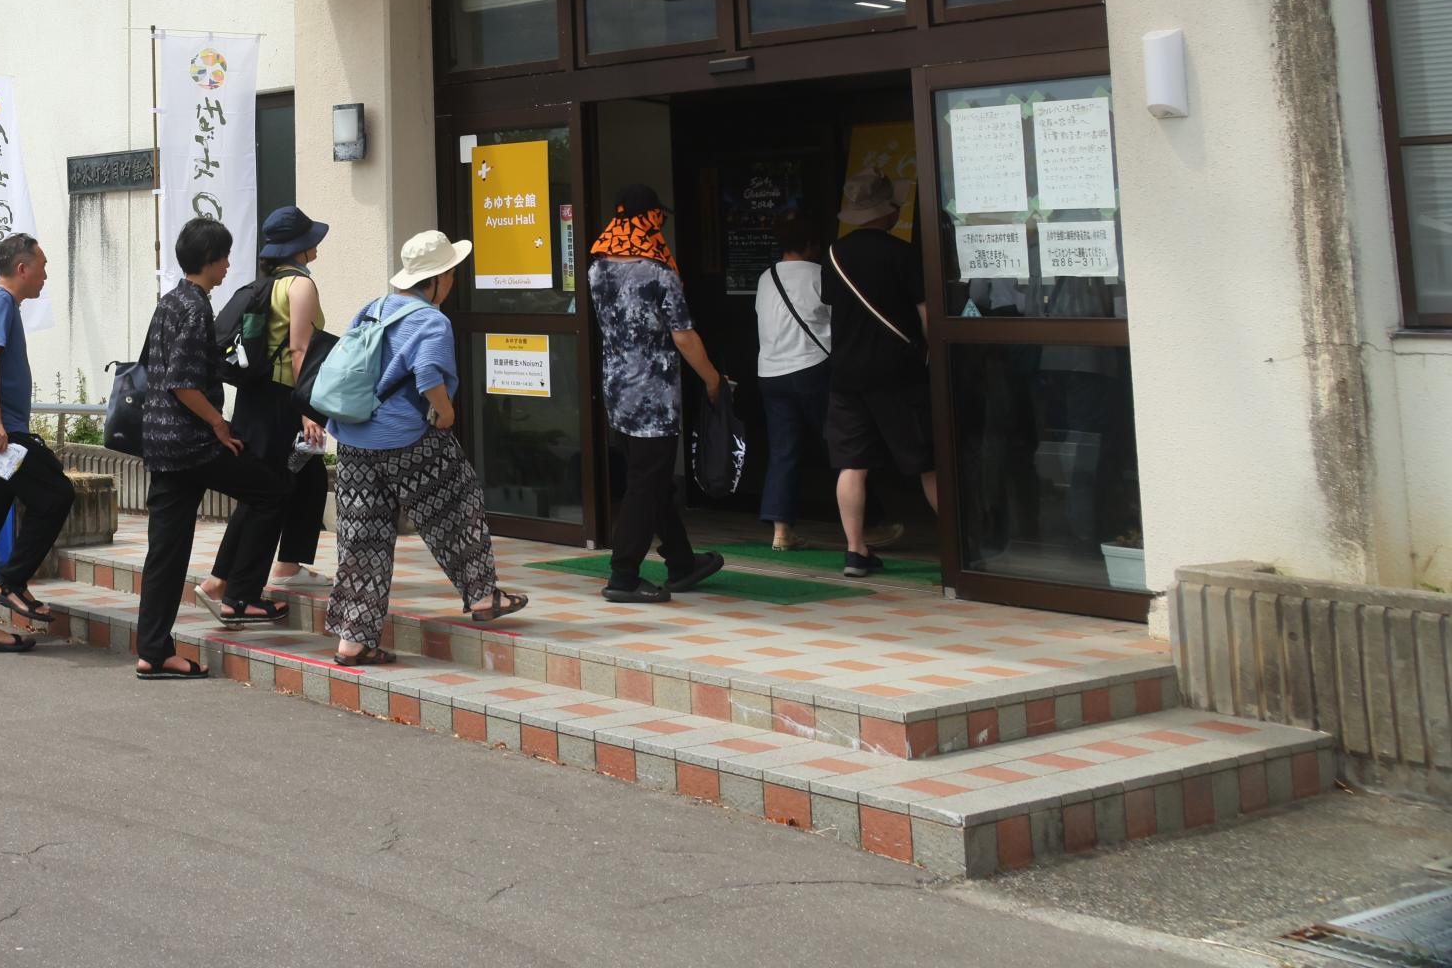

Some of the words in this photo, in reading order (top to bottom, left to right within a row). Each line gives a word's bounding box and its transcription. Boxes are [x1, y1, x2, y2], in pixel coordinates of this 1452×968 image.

[193, 97, 227, 180] Earth
[483, 193, 536, 209] あゆす会館
[485, 215, 513, 228] Ayusu
[515, 213, 536, 226] Hall
[1060, 257, 1109, 267] 86-3111
